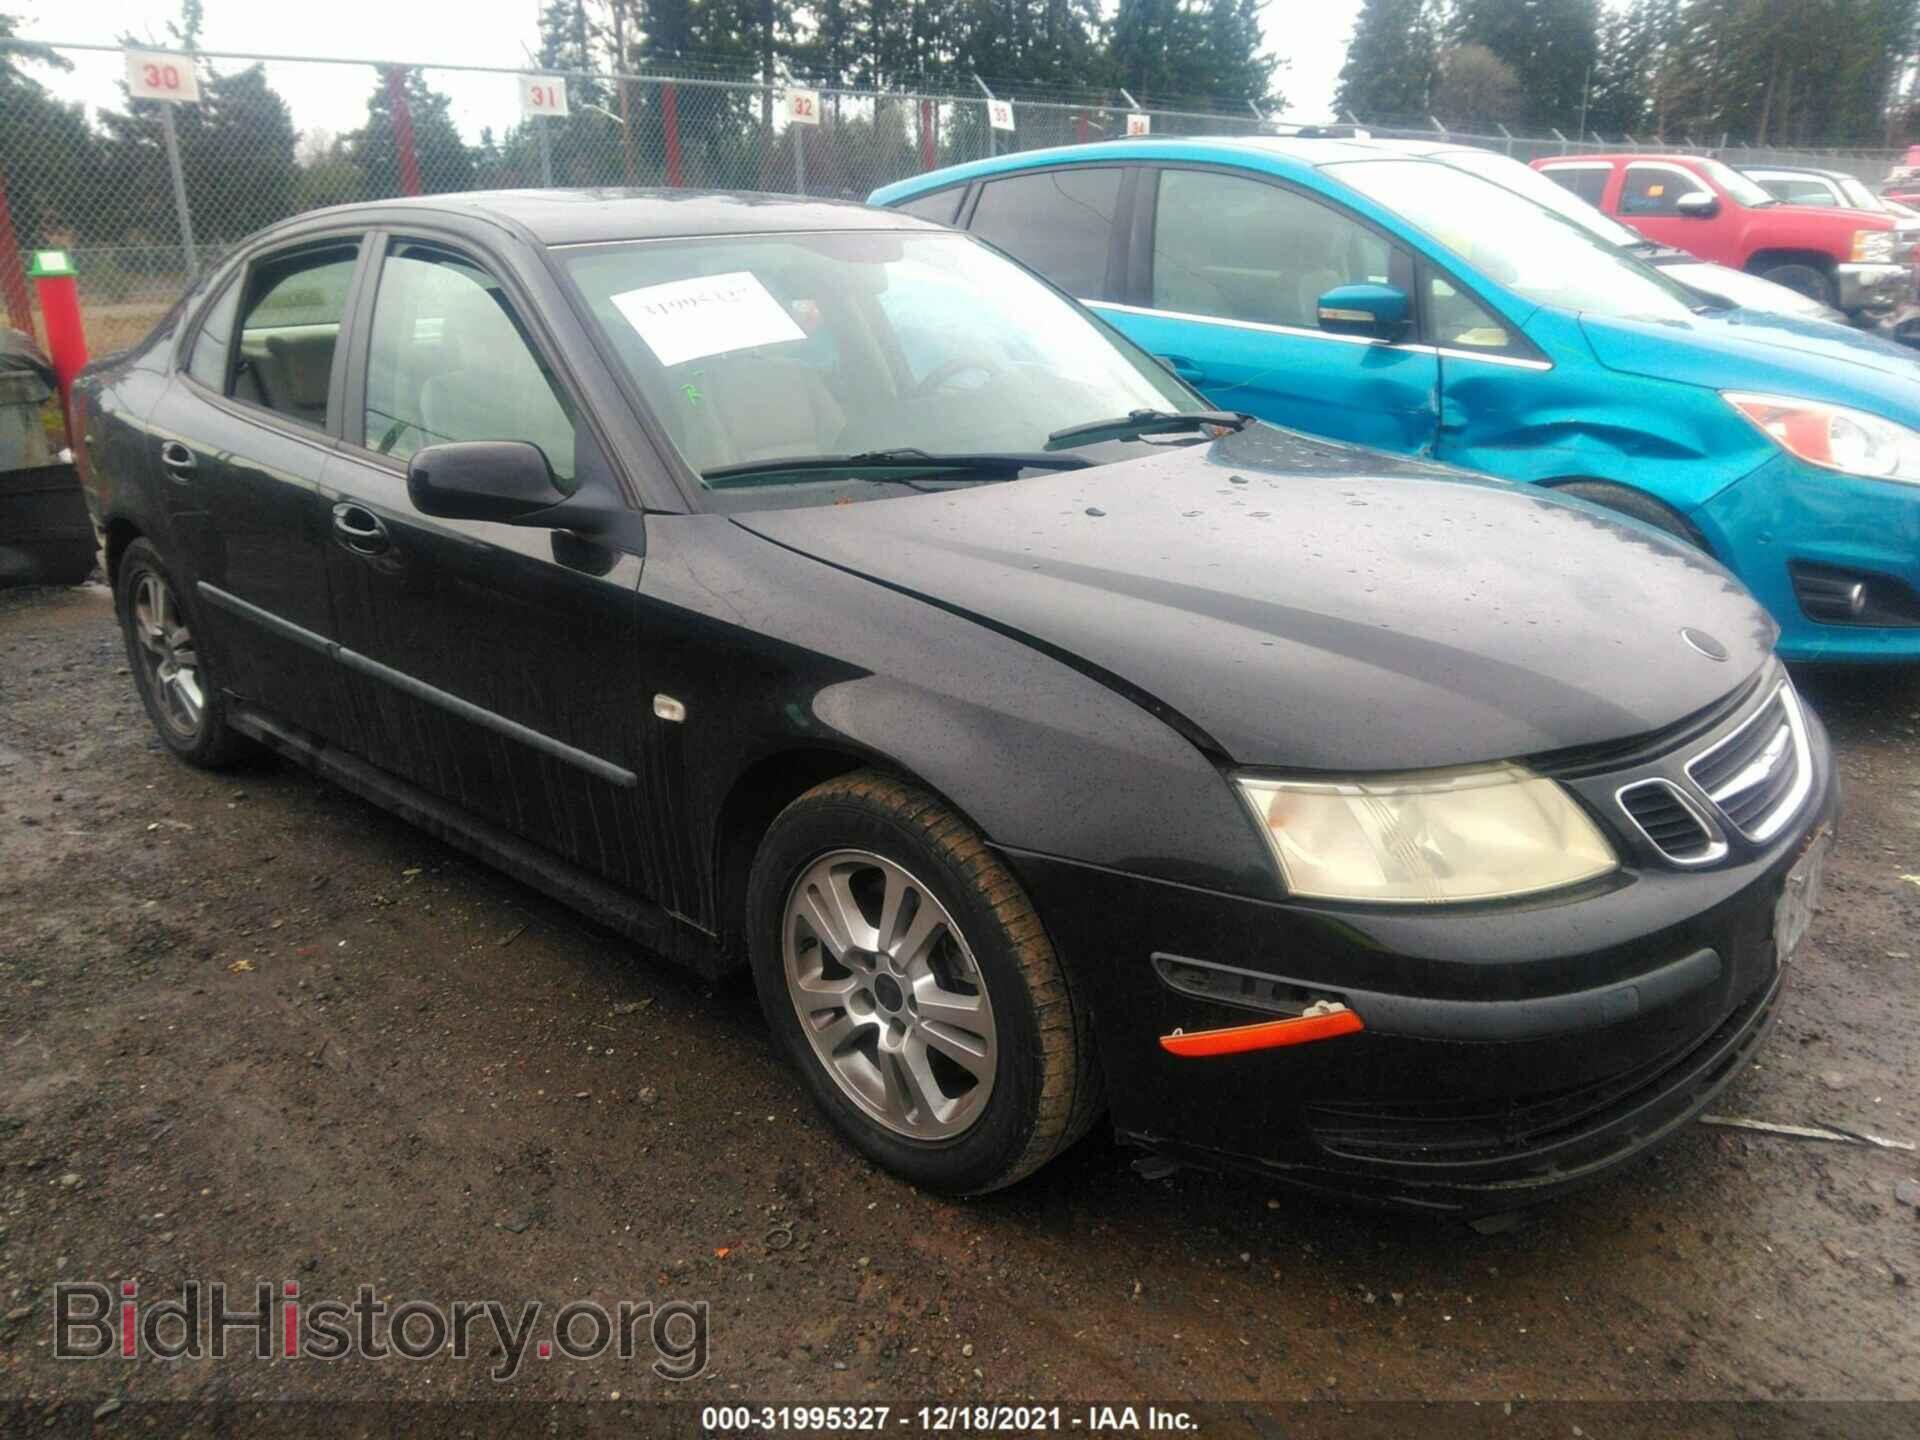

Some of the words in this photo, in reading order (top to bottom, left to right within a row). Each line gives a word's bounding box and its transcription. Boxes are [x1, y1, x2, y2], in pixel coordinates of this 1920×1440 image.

[142, 63, 179, 90] 30
[530, 86, 556, 107] 31
[794, 96, 813, 117] 32
